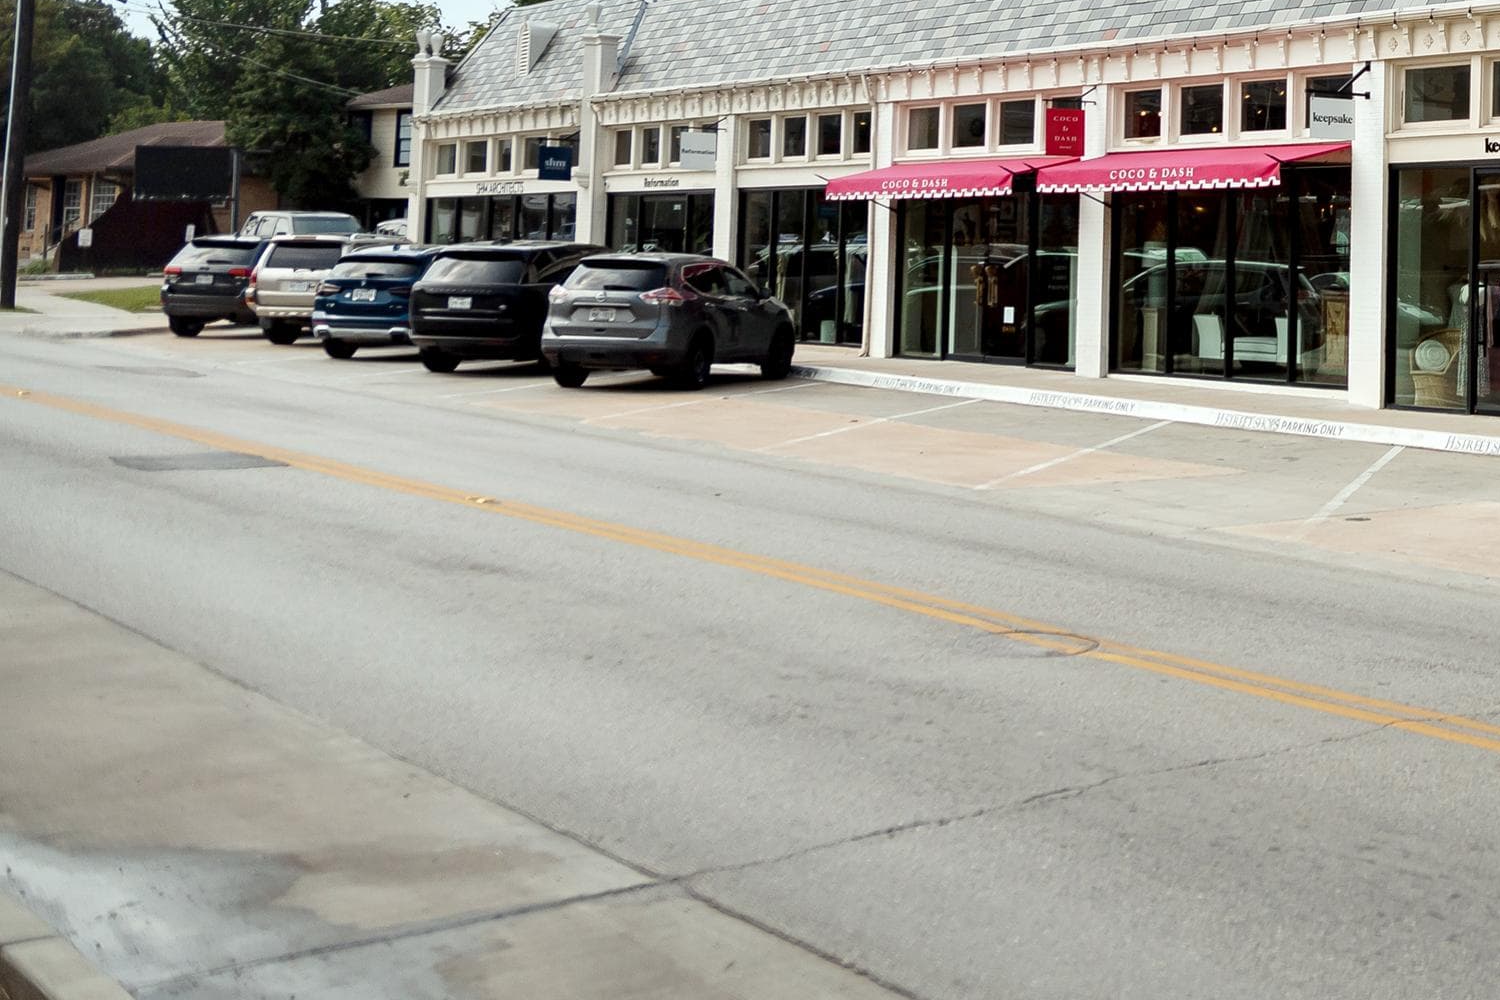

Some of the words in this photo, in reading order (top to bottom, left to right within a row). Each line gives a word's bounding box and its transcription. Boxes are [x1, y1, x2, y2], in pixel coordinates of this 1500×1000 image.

[1313, 112, 1353, 126] keepsake
[545, 157, 567, 167] shm
[1109, 169, 1145, 180] COCO
[1148, 168, 1157, 179] &
[1161, 167, 1194, 178] DASH
[644, 177, 679, 188] Reformation
[882, 180, 909, 189] COCO
[912, 179, 919, 188] &
[922, 179, 948, 188] DASH
[1083, 398, 1115, 410] PARKING
[1115, 401, 1136, 412] ONLY
[1281, 420, 1318, 434] PARKING
[1319, 423, 1345, 436] ONLY
